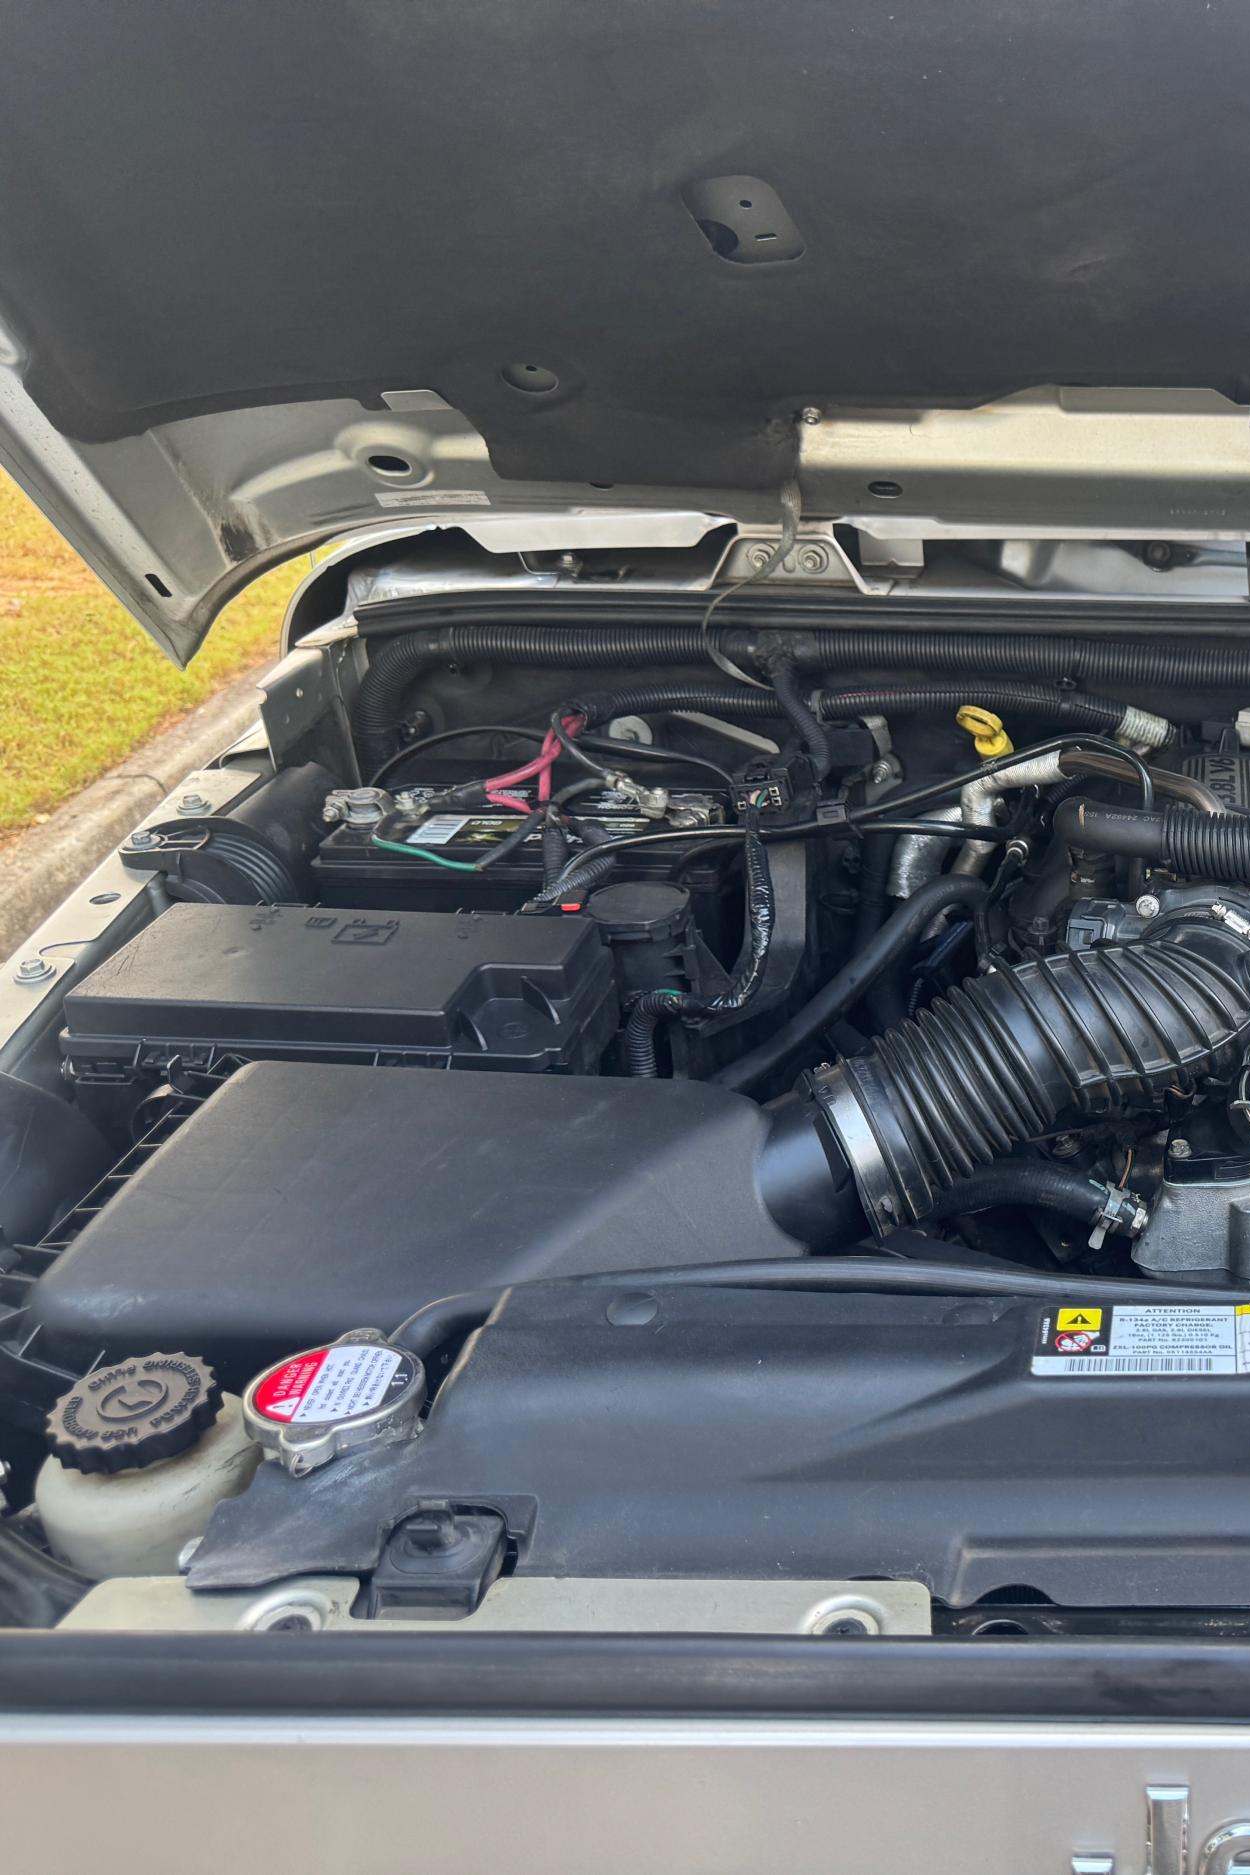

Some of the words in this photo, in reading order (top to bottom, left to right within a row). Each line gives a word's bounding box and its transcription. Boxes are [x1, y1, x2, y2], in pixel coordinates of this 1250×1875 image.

[1209, 757, 1236, 774] V6
[143, 1359, 201, 1387] STEERING
[273, 1363, 303, 1397] DANGER
[289, 1361, 318, 1395] WARNING
[390, 1373, 409, 1386] 1.1
[149, 1385, 201, 1429] POWER
